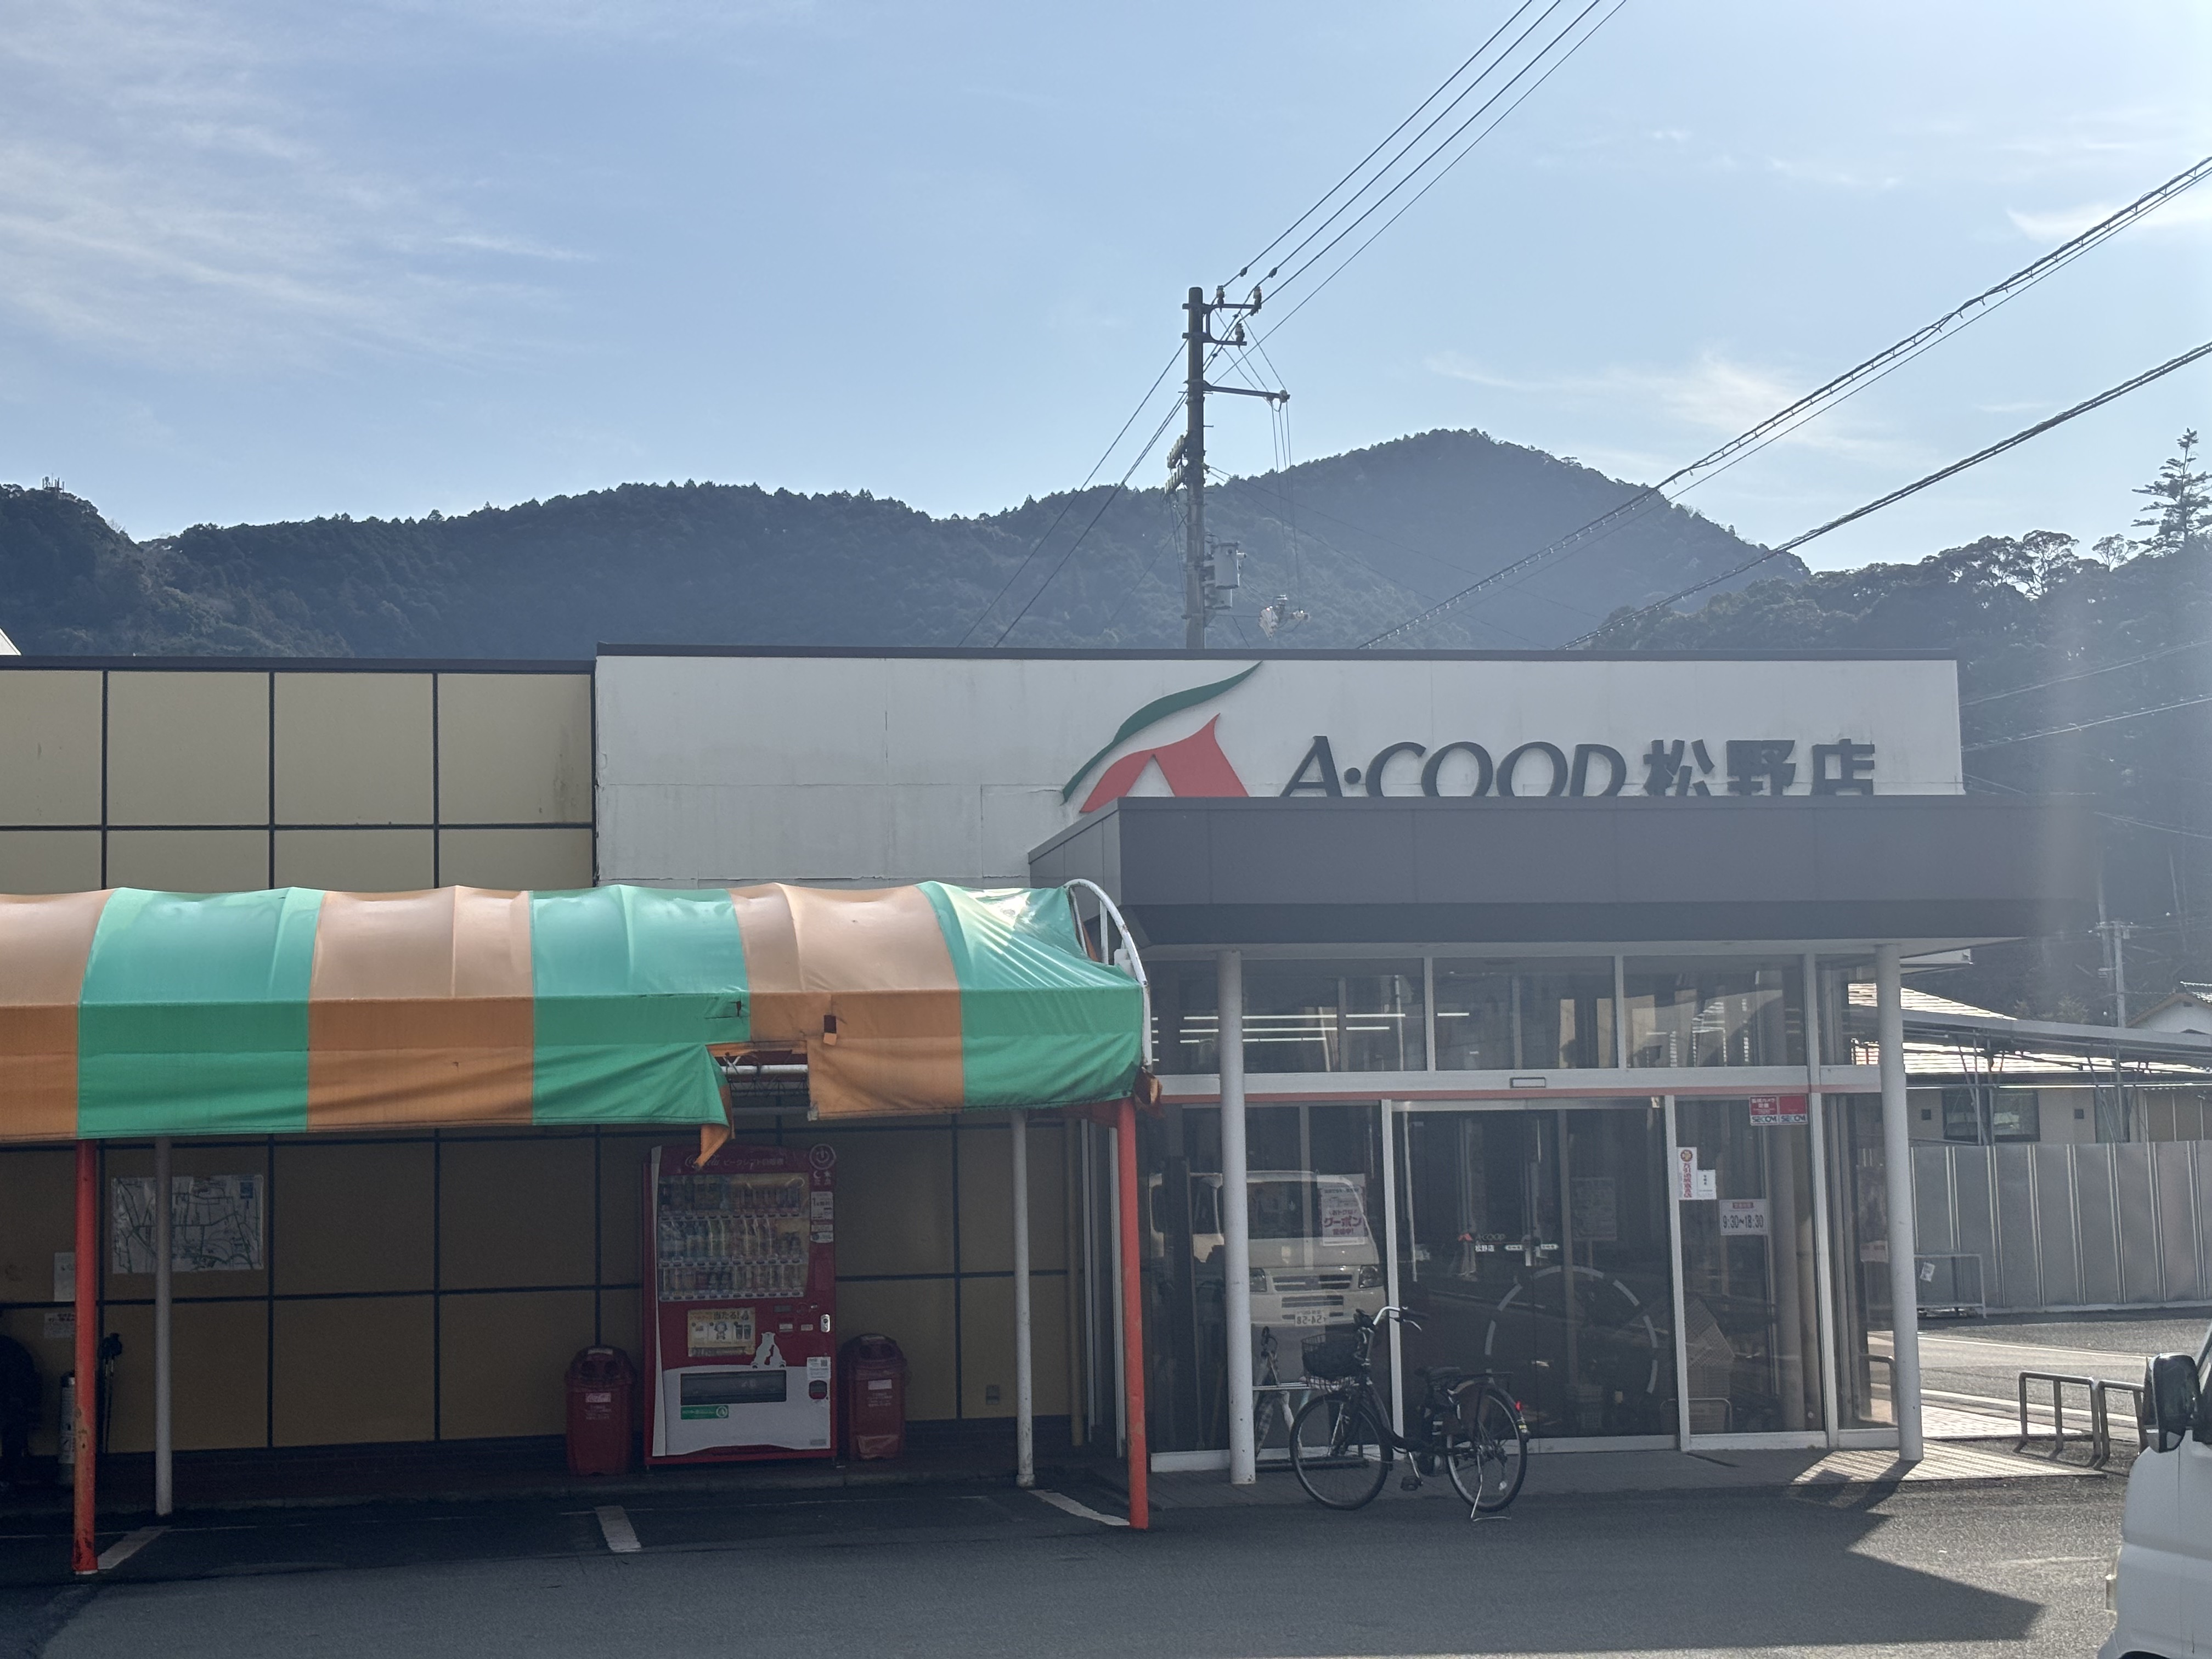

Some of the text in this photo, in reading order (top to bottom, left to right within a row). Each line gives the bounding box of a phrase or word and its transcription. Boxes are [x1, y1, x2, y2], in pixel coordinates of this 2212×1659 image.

[1643, 738, 1875, 795] 松野店
[1324, 1215, 1362, 1228] クーポン
